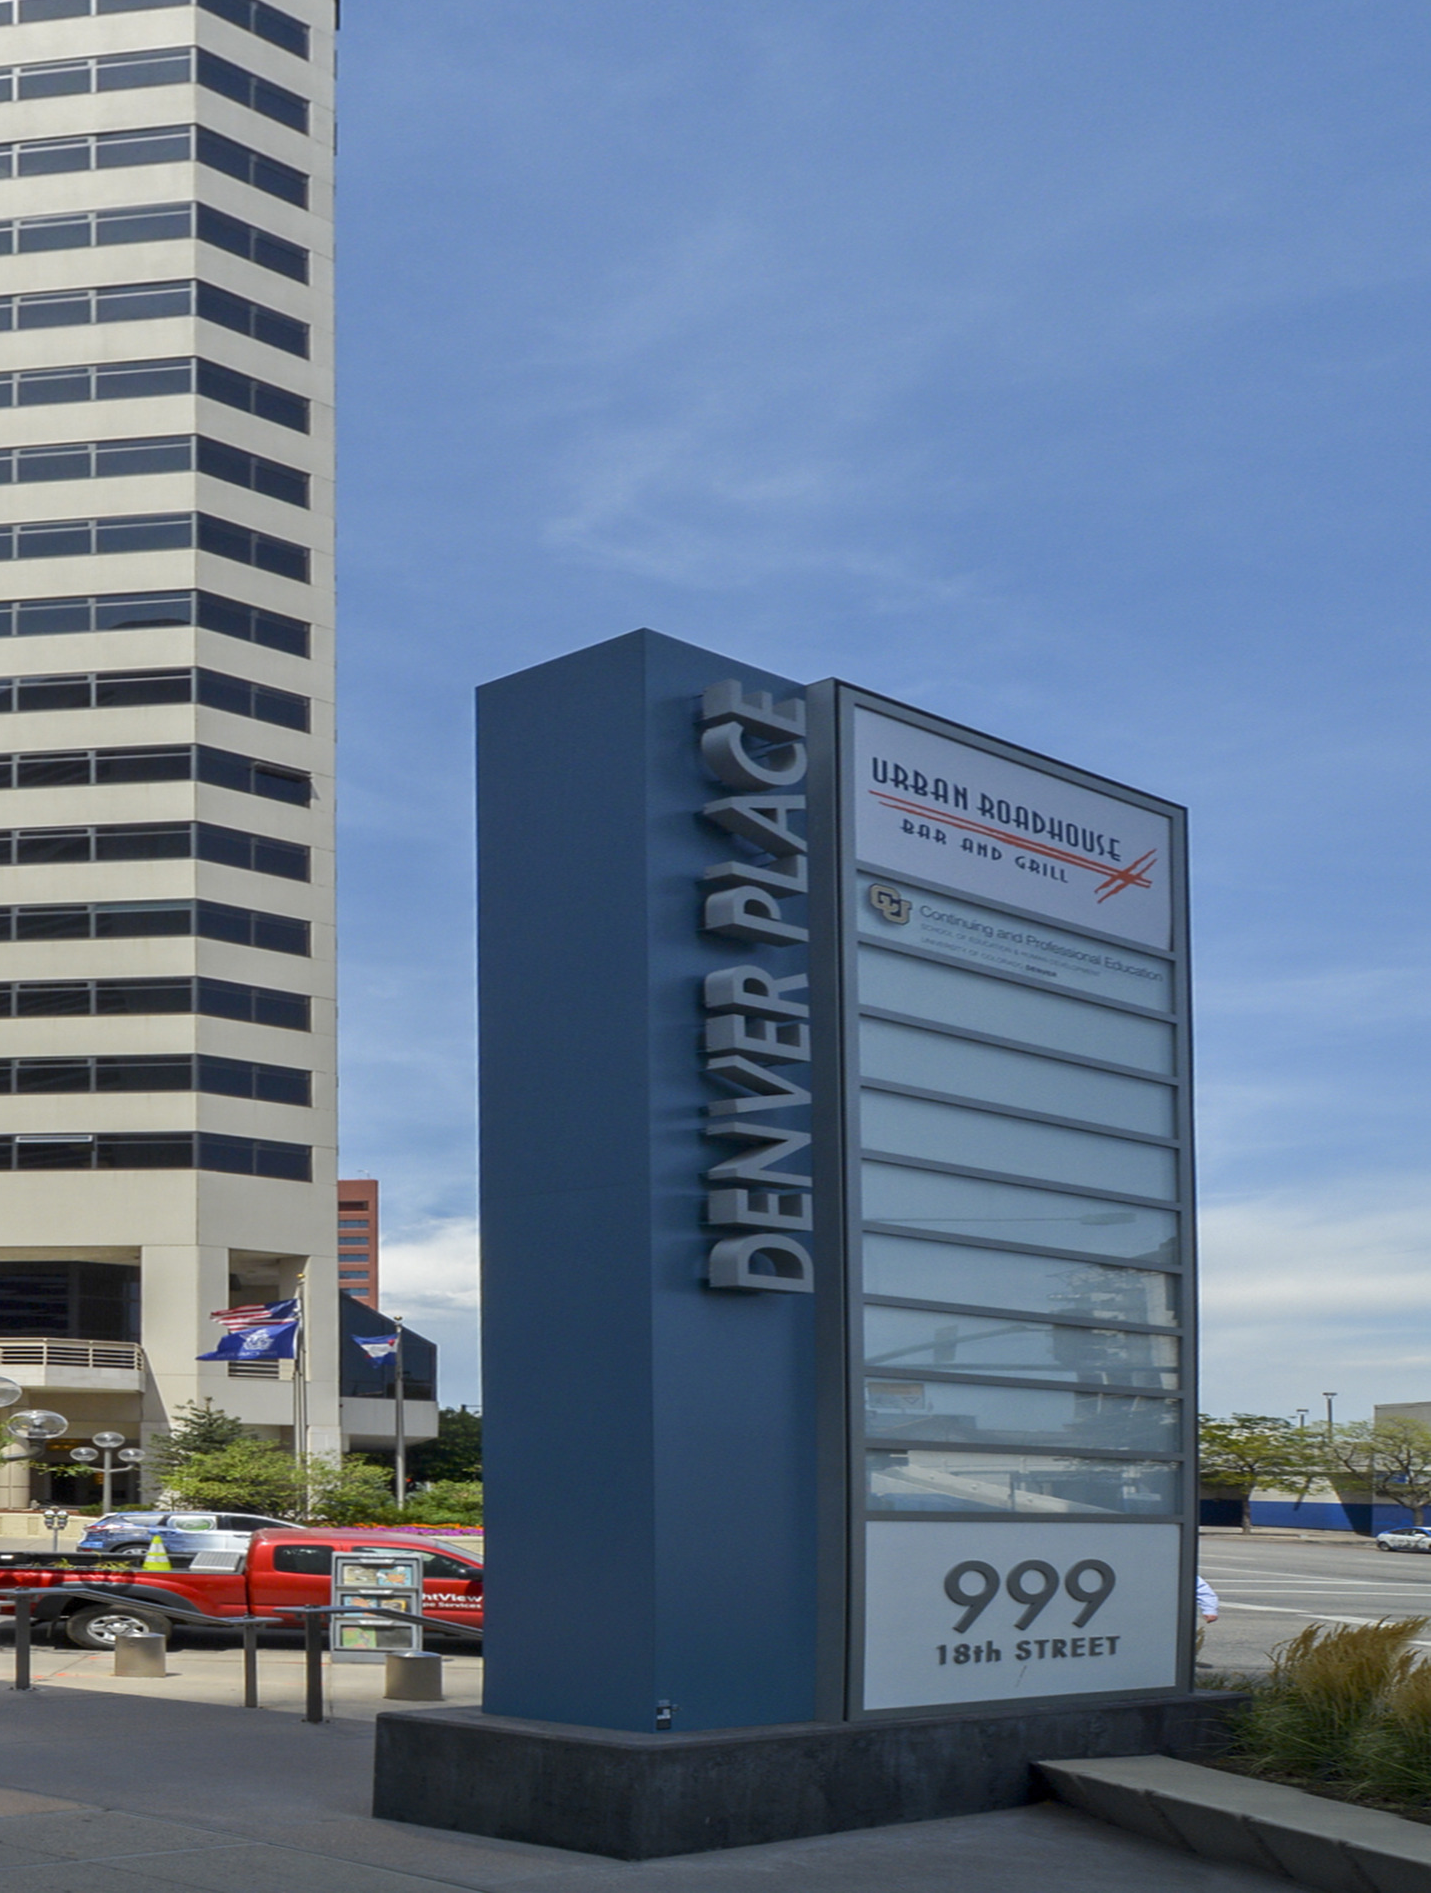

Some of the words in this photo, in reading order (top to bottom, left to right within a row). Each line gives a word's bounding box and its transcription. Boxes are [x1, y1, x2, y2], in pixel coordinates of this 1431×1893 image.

[700, 678, 810, 948] PLACE
[872, 756, 970, 811] URBAN
[977, 791, 1122, 861] ROADHOUSE
[900, 818, 947, 845] BAR
[962, 837, 1003, 861] AND
[1015, 855, 1069, 883] GRILL
[919, 905, 994, 938] Continuing
[996, 928, 1023, 944] and
[1025, 934, 1102, 965] Professional
[1104, 956, 1164, 982] Education
[704, 965, 814, 1294] DENVER
[422, 1593, 483, 1603] htView
[944, 1559, 1116, 1634] 999
[935, 1640, 1002, 1665] 18th
[1015, 1635, 1121, 1662] STREET
